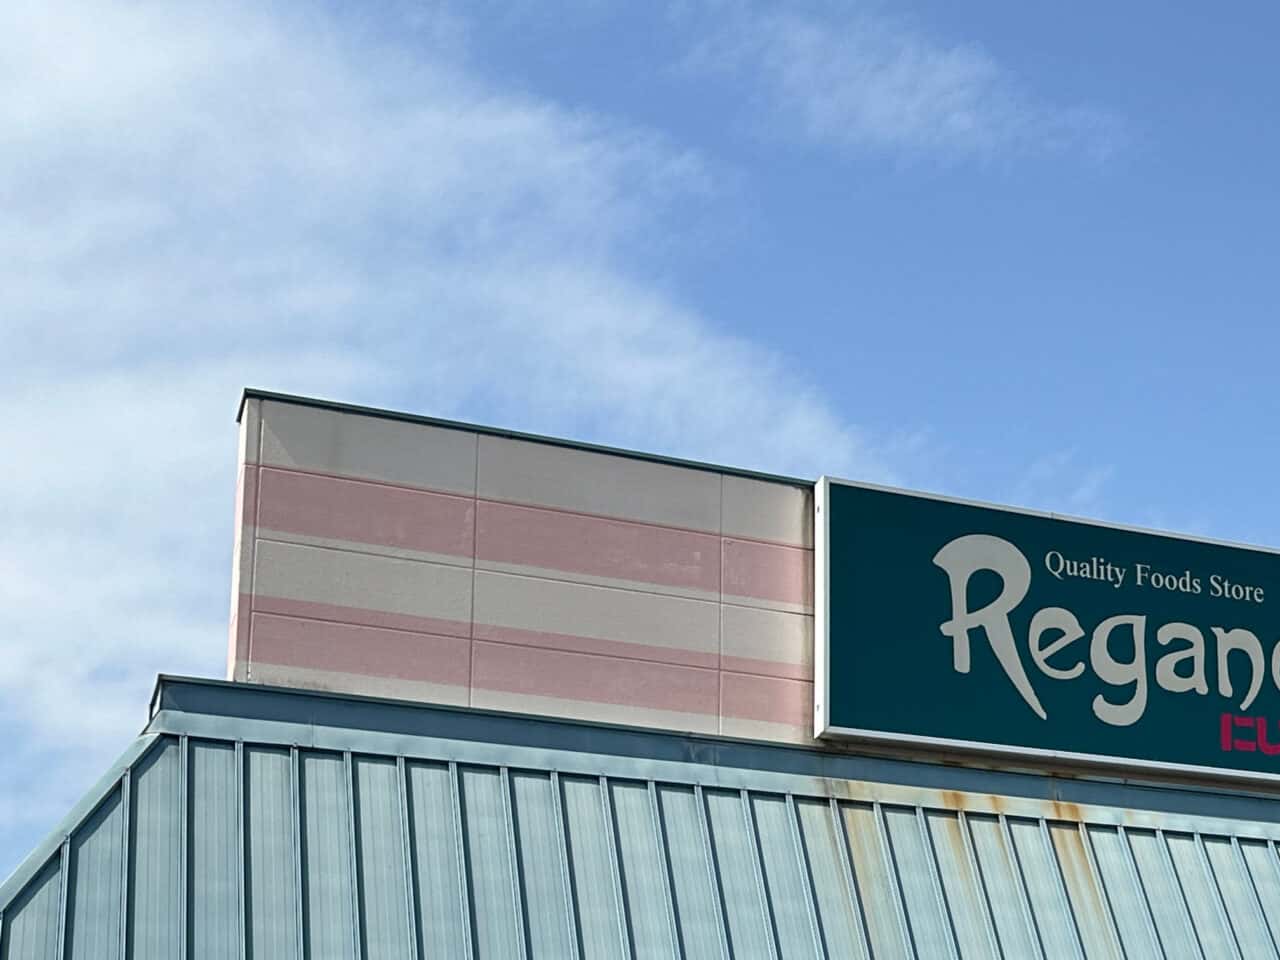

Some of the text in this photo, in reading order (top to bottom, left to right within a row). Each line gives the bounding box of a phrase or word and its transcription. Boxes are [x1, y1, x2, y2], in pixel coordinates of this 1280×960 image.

[1045, 551, 1265, 604] Quality Foods Store
